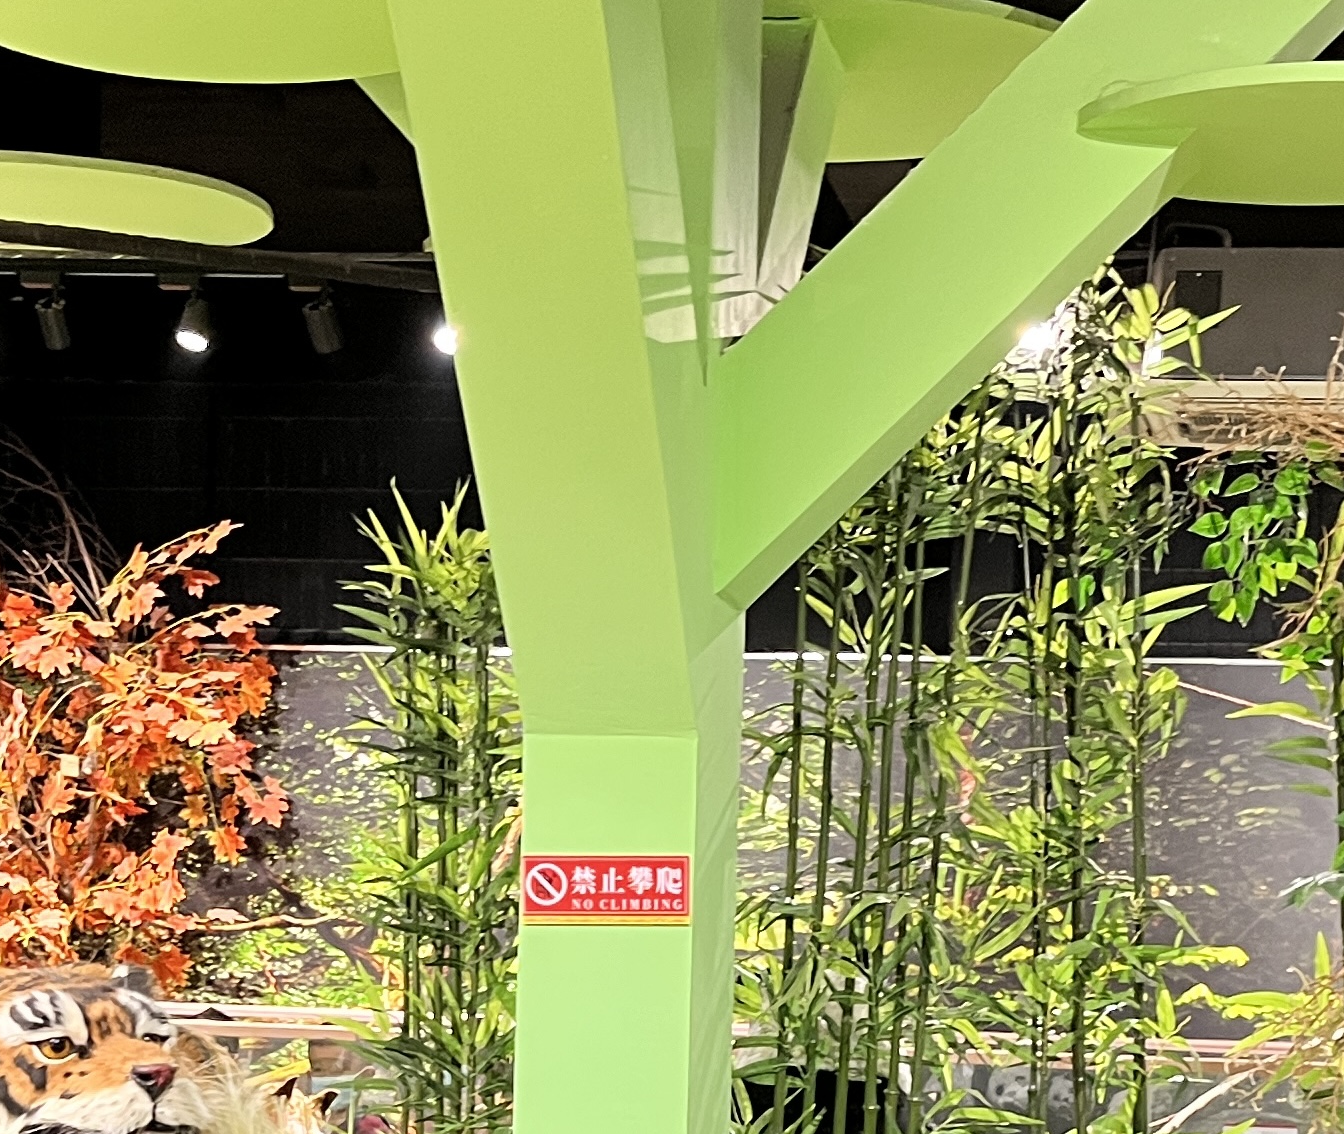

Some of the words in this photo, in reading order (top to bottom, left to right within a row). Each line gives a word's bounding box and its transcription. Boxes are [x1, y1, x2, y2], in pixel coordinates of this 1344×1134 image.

[570, 866, 683, 894] 禁止攀爬
[571, 899, 593, 910] NO
[599, 899, 683, 911] CLIMBING
